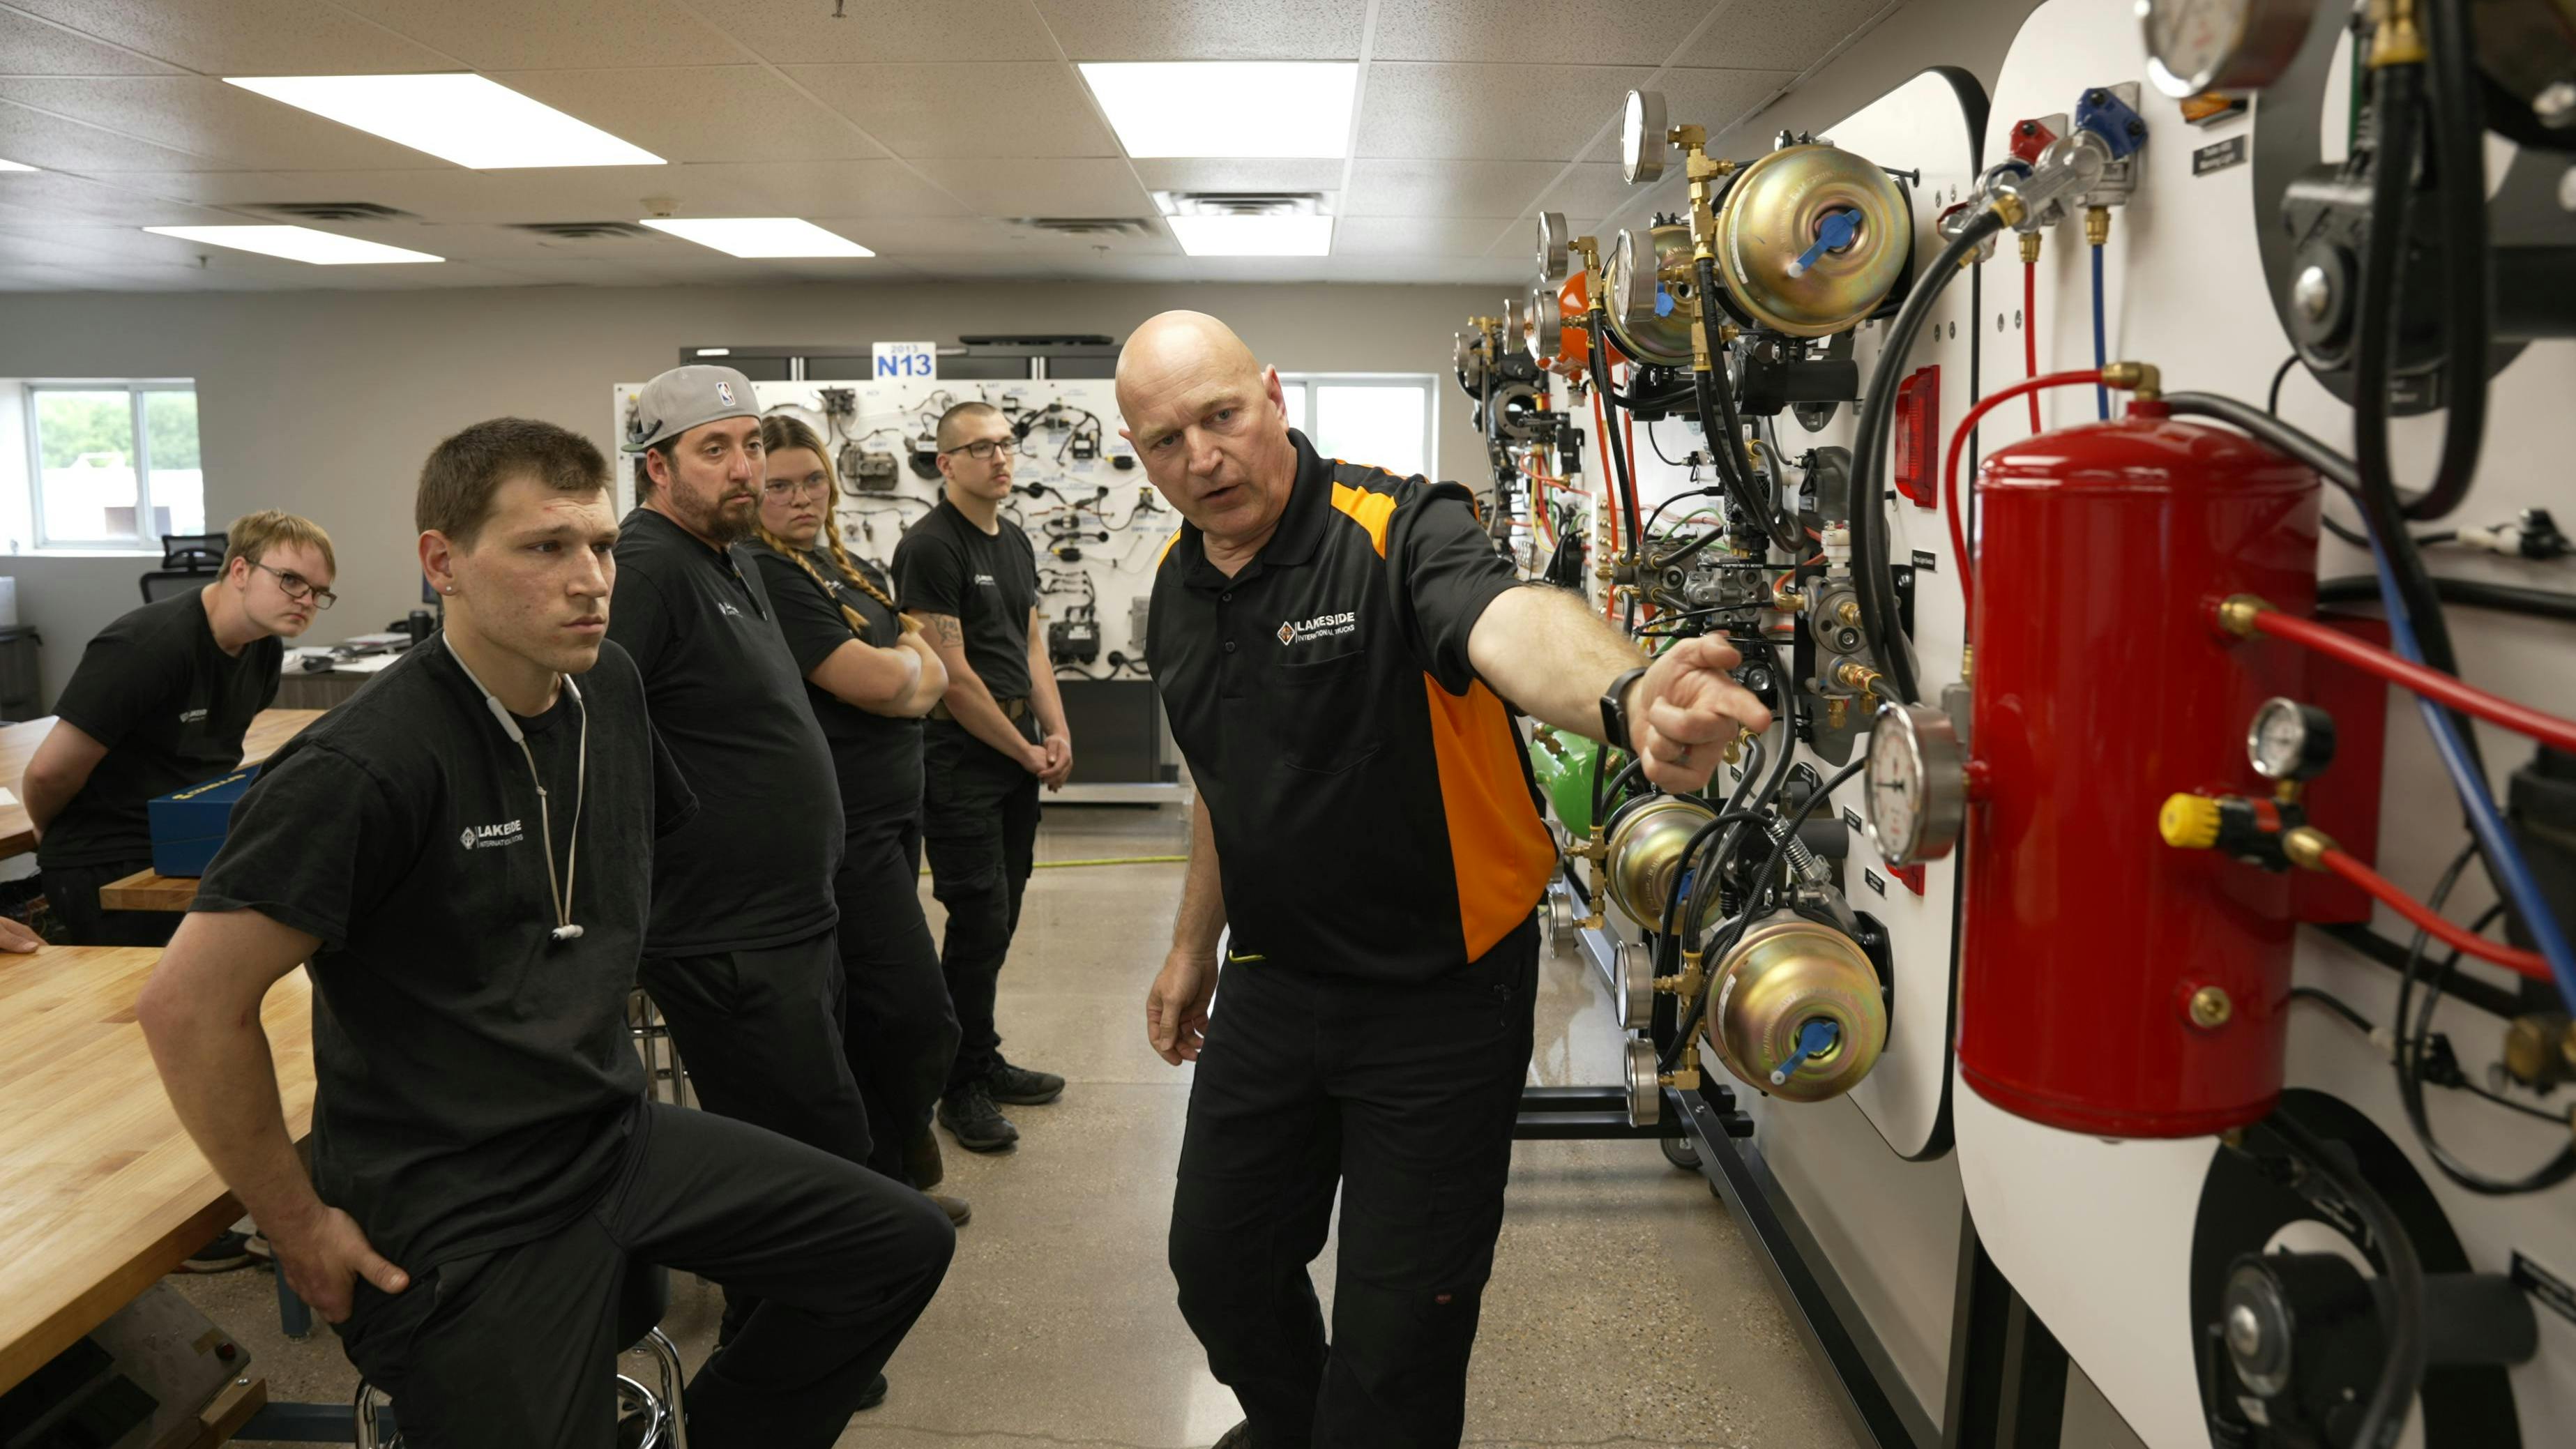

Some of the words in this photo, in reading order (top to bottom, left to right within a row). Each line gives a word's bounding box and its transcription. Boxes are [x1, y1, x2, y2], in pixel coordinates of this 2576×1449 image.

[891, 345, 918, 354] 2013
[877, 354, 932, 377] N13
[1297, 612, 1355, 631] LAKESIDE
